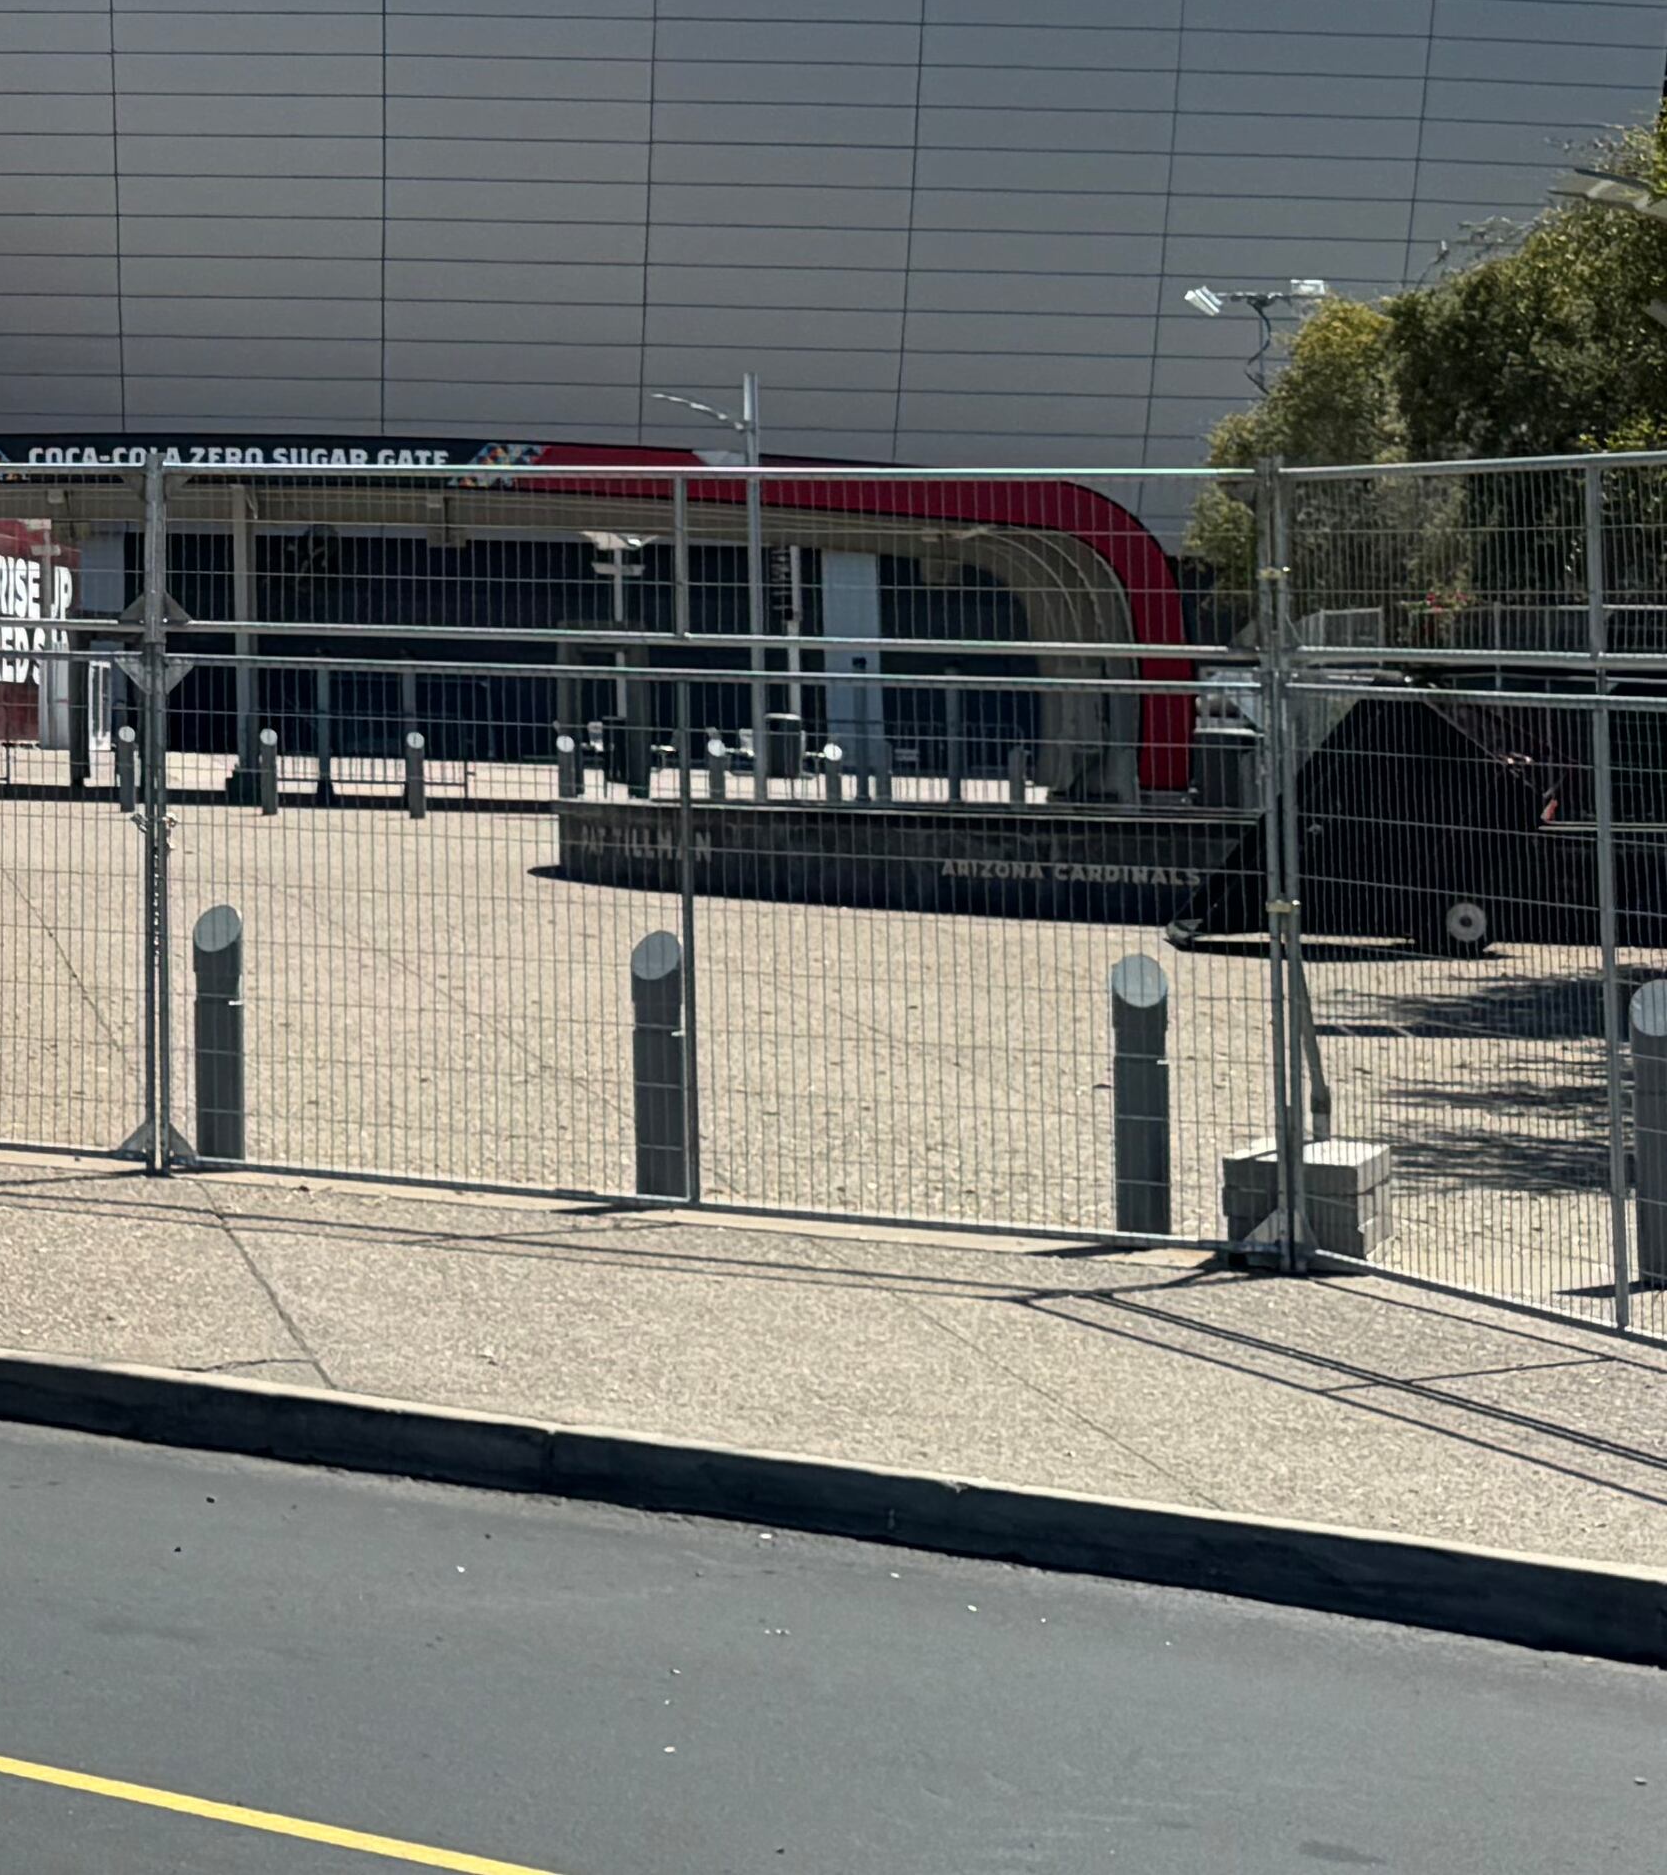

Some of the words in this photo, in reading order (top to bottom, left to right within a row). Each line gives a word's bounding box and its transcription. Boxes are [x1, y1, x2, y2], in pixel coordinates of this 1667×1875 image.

[189, 446, 264, 465] ZERO
[273, 447, 369, 466] SUGAR
[377, 449, 449, 466] GATE
[941, 859, 1044, 880] ARIZONA
[1054, 863, 1201, 887] CARDINALS
